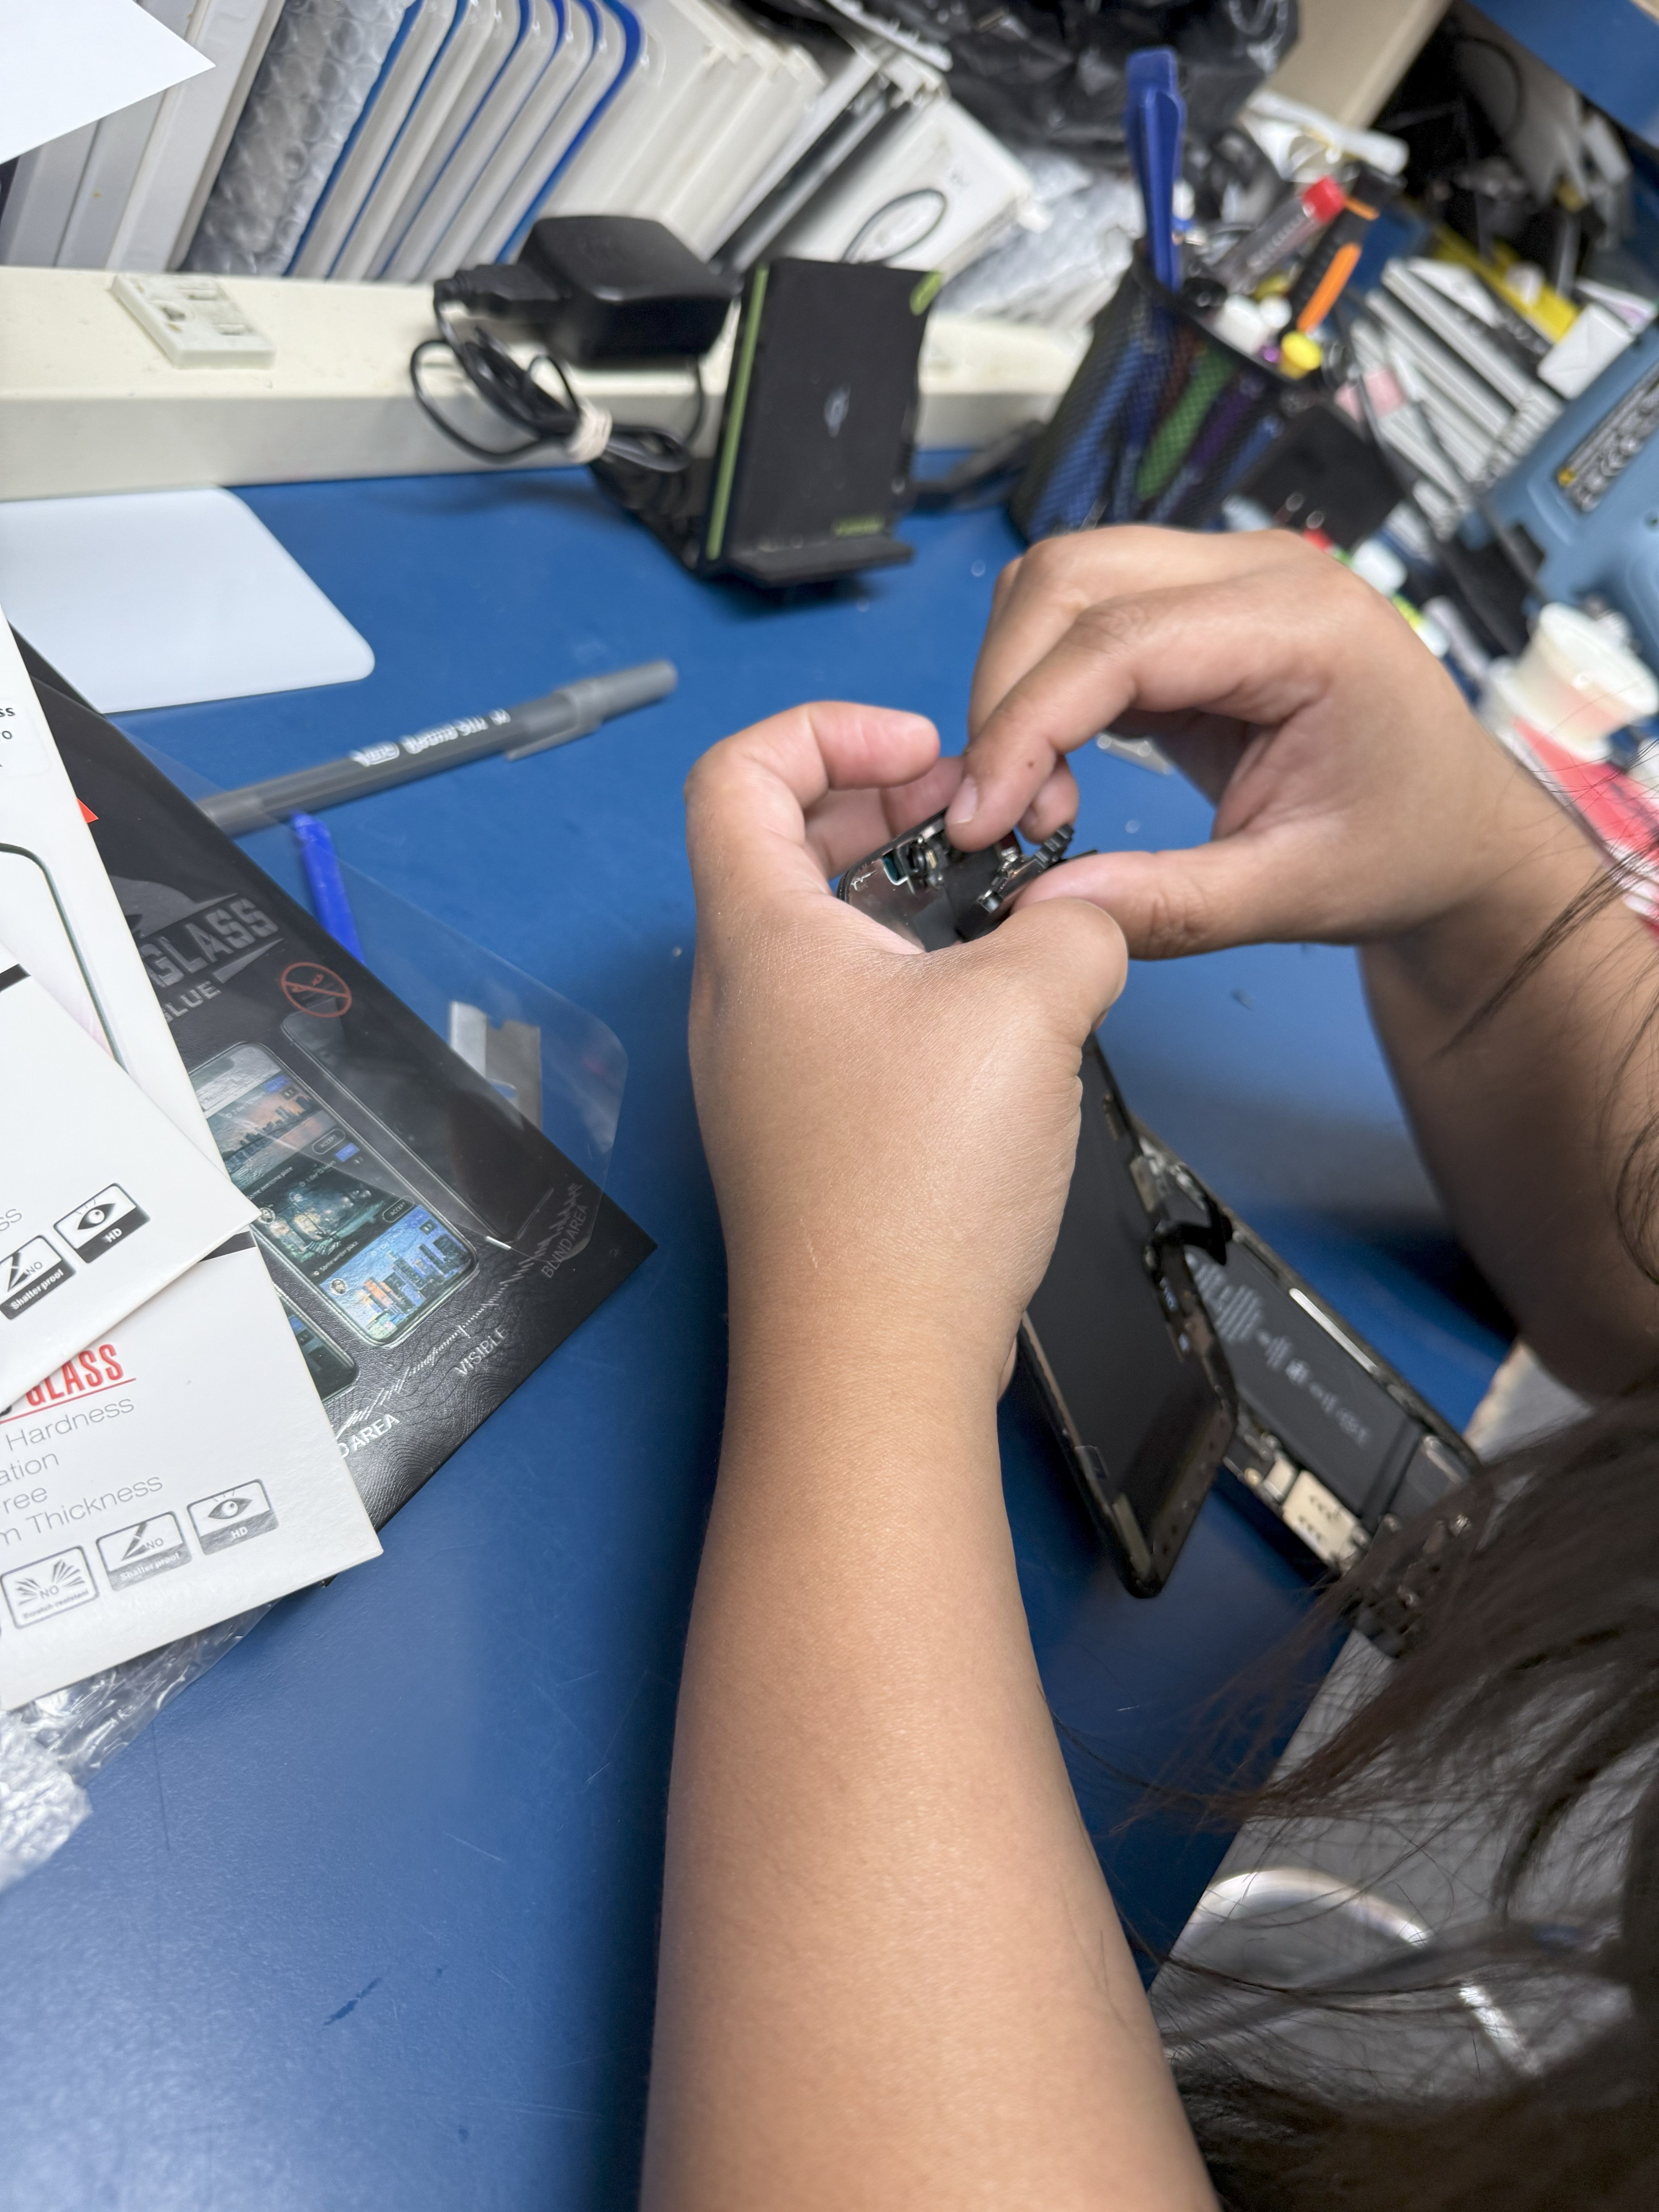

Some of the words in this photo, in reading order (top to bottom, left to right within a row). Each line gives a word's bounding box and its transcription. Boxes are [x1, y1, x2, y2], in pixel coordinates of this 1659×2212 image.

[139, 898, 278, 988] GLASS
[105, 1227, 123, 1243] HD
[541, 1238, 572, 1278] BLIND
[567, 1204, 589, 1240] AREA
[453, 1324, 510, 1375] VISIBLE
[6, 1398, 134, 1451] Hardness
[352, 1414, 400, 1451] AREA
[0, 1487, 48, 1514] ree
[26, 1476, 163, 1534] Thickness
[144, 1537, 164, 1550] NO
[231, 1525, 249, 1539] HD
[40, 1584, 59, 1600] NO
